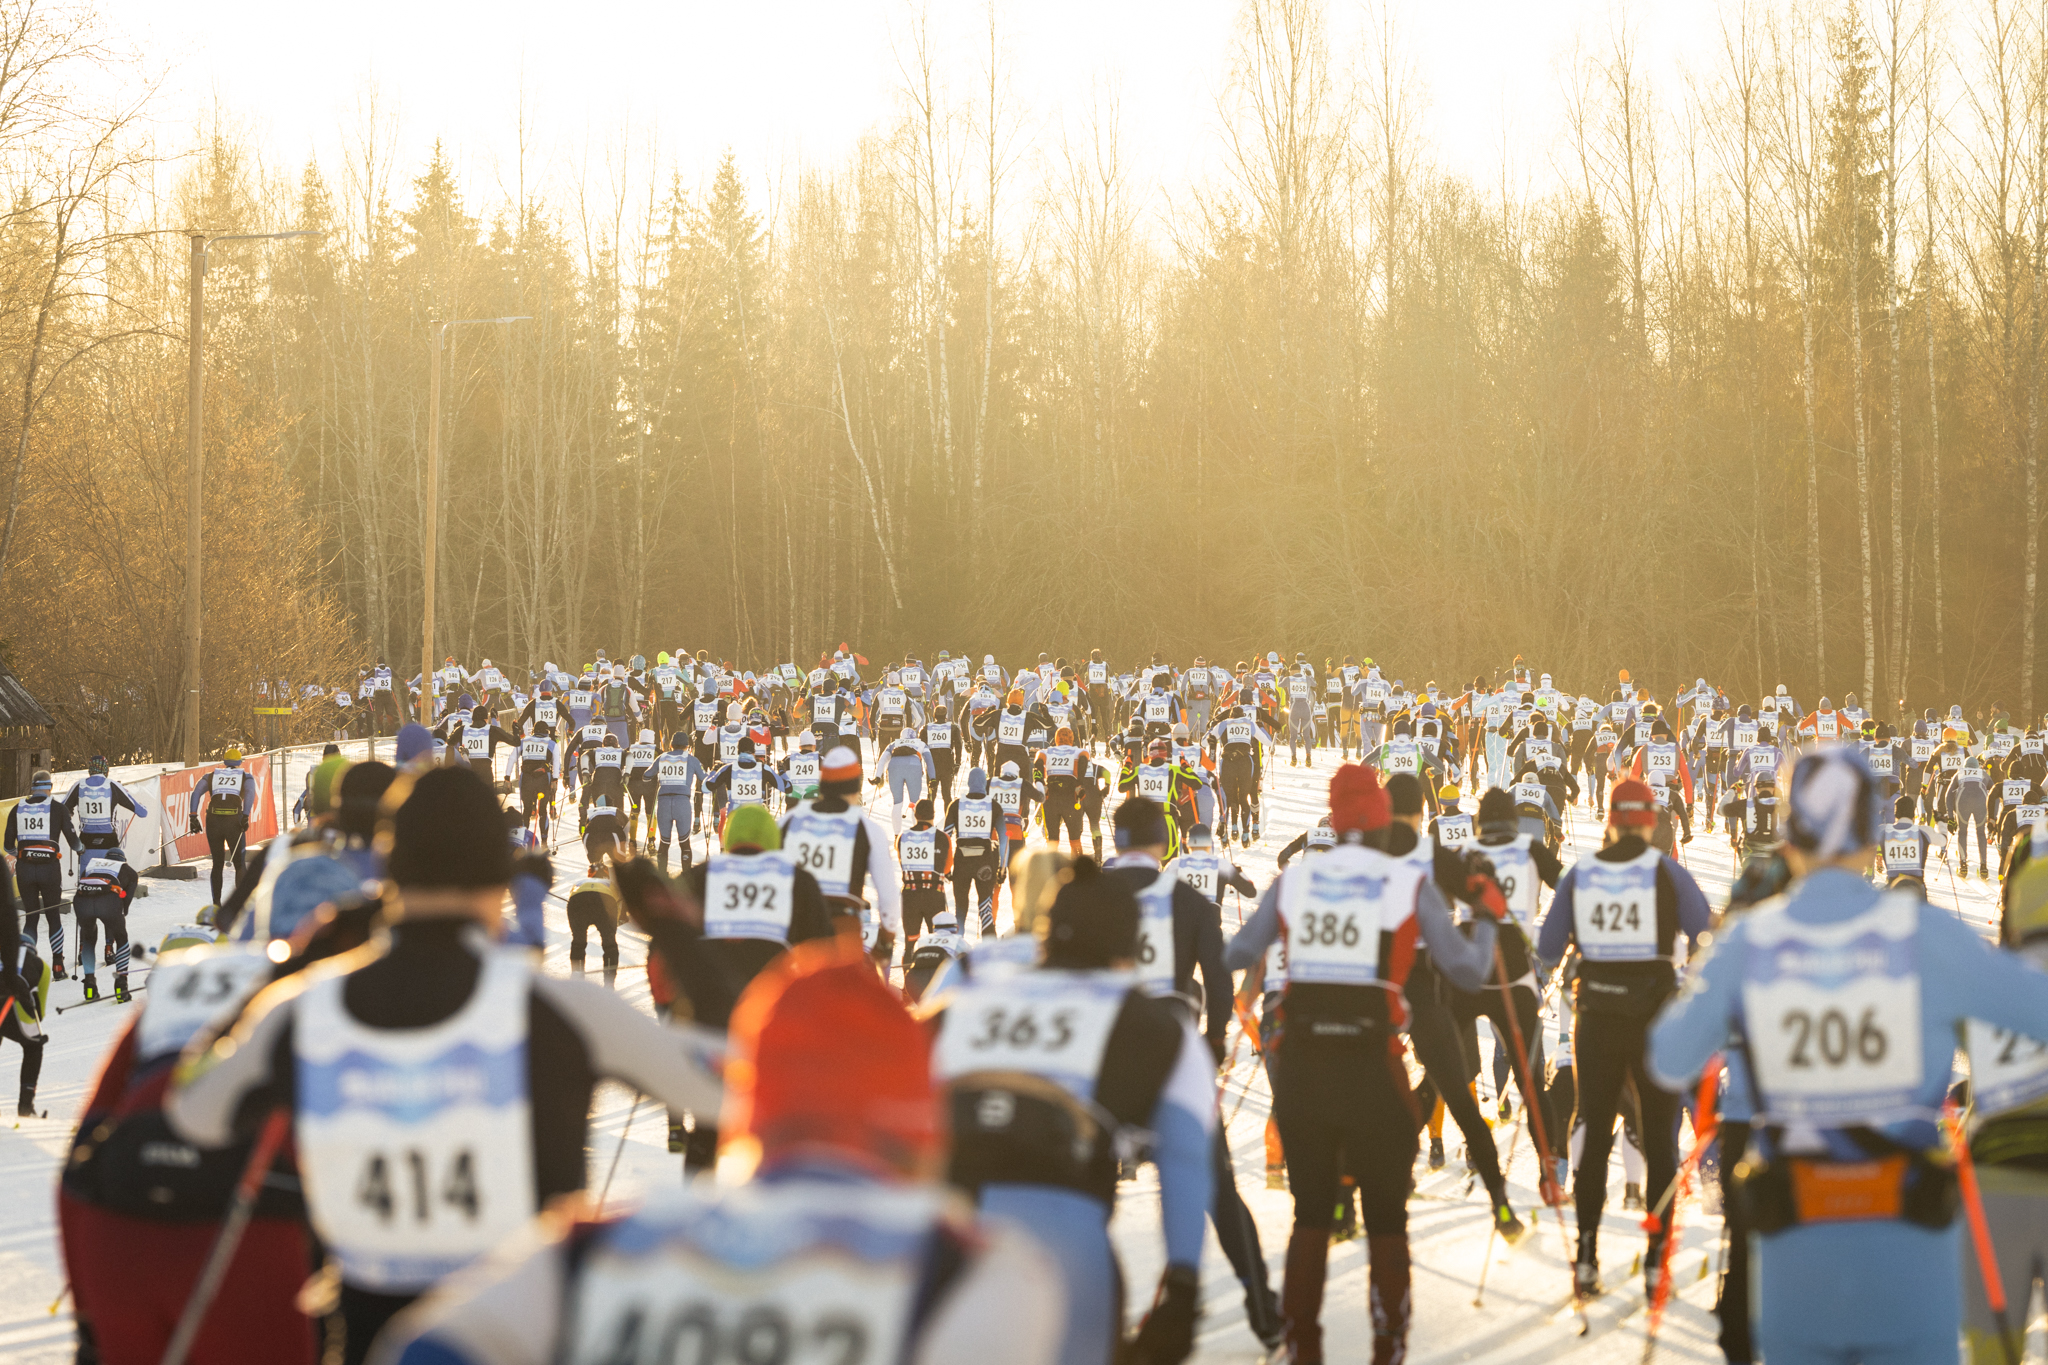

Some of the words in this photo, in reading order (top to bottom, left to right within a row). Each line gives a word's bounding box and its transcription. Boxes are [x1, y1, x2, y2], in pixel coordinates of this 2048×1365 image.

[661, 677, 673, 685] 217
[1191, 672, 1206, 680] 4172
[380, 679, 389, 687] 85
[1291, 685, 1307, 693] 4058
[1370, 690, 1382, 698] 144
[888, 697, 901, 705] 108
[1699, 701, 1711, 709] 168
[540, 710, 554, 720] 193
[817, 706, 831, 715] 164
[1151, 707, 1165, 716] 189
[698, 713, 713, 723] 235
[588, 727, 602, 735] 183
[1003, 726, 1018, 737] 321
[1229, 726, 1250, 737] 4073
[1821, 723, 1834, 732] 194
[932, 732, 947, 741] 260
[1598, 735, 1616, 743] 4074
[1640, 730, 1650, 739] 16
[1740, 733, 1754, 743] 118
[467, 739, 483, 750] 201
[525, 744, 545, 754] 4113
[1999, 740, 2011, 748] 142
[2025, 741, 2040, 749] 178
[632, 751, 652, 760] 4076
[1916, 746, 1930, 755] 281
[1051, 757, 1070, 766] 222
[1394, 756, 1413, 768] 396
[1653, 756, 1671, 766] 253
[1754, 755, 1769, 765] 271
[1870, 758, 1891, 769] 4048
[1946, 757, 1962, 767] 278
[661, 765, 684, 776] 4018
[795, 765, 814, 775] 249
[218, 776, 236, 786] 275
[1143, 778, 1163, 792] 304
[737, 783, 757, 796] 358
[1521, 788, 1541, 799] 360
[2008, 787, 2025, 797] 231
[993, 792, 1018, 805] 4133
[86, 802, 103, 814] 131
[2021, 809, 2041, 819] 225
[24, 817, 44, 830] 184
[964, 815, 986, 828] 356
[1314, 830, 1336, 839] 335
[1446, 827, 1468, 841] 354
[798, 842, 835, 870] 361
[906, 847, 929, 860] 336
[1888, 845, 1917, 860] 4143
[1186, 873, 1209, 889] 331
[724, 883, 776, 911] 392
[1590, 902, 1640, 932] 424
[1299, 912, 1360, 947] 386
[968, 1004, 1080, 1057] 365
[1782, 1006, 1889, 1069] 206
[356, 1142, 481, 1228] 414
